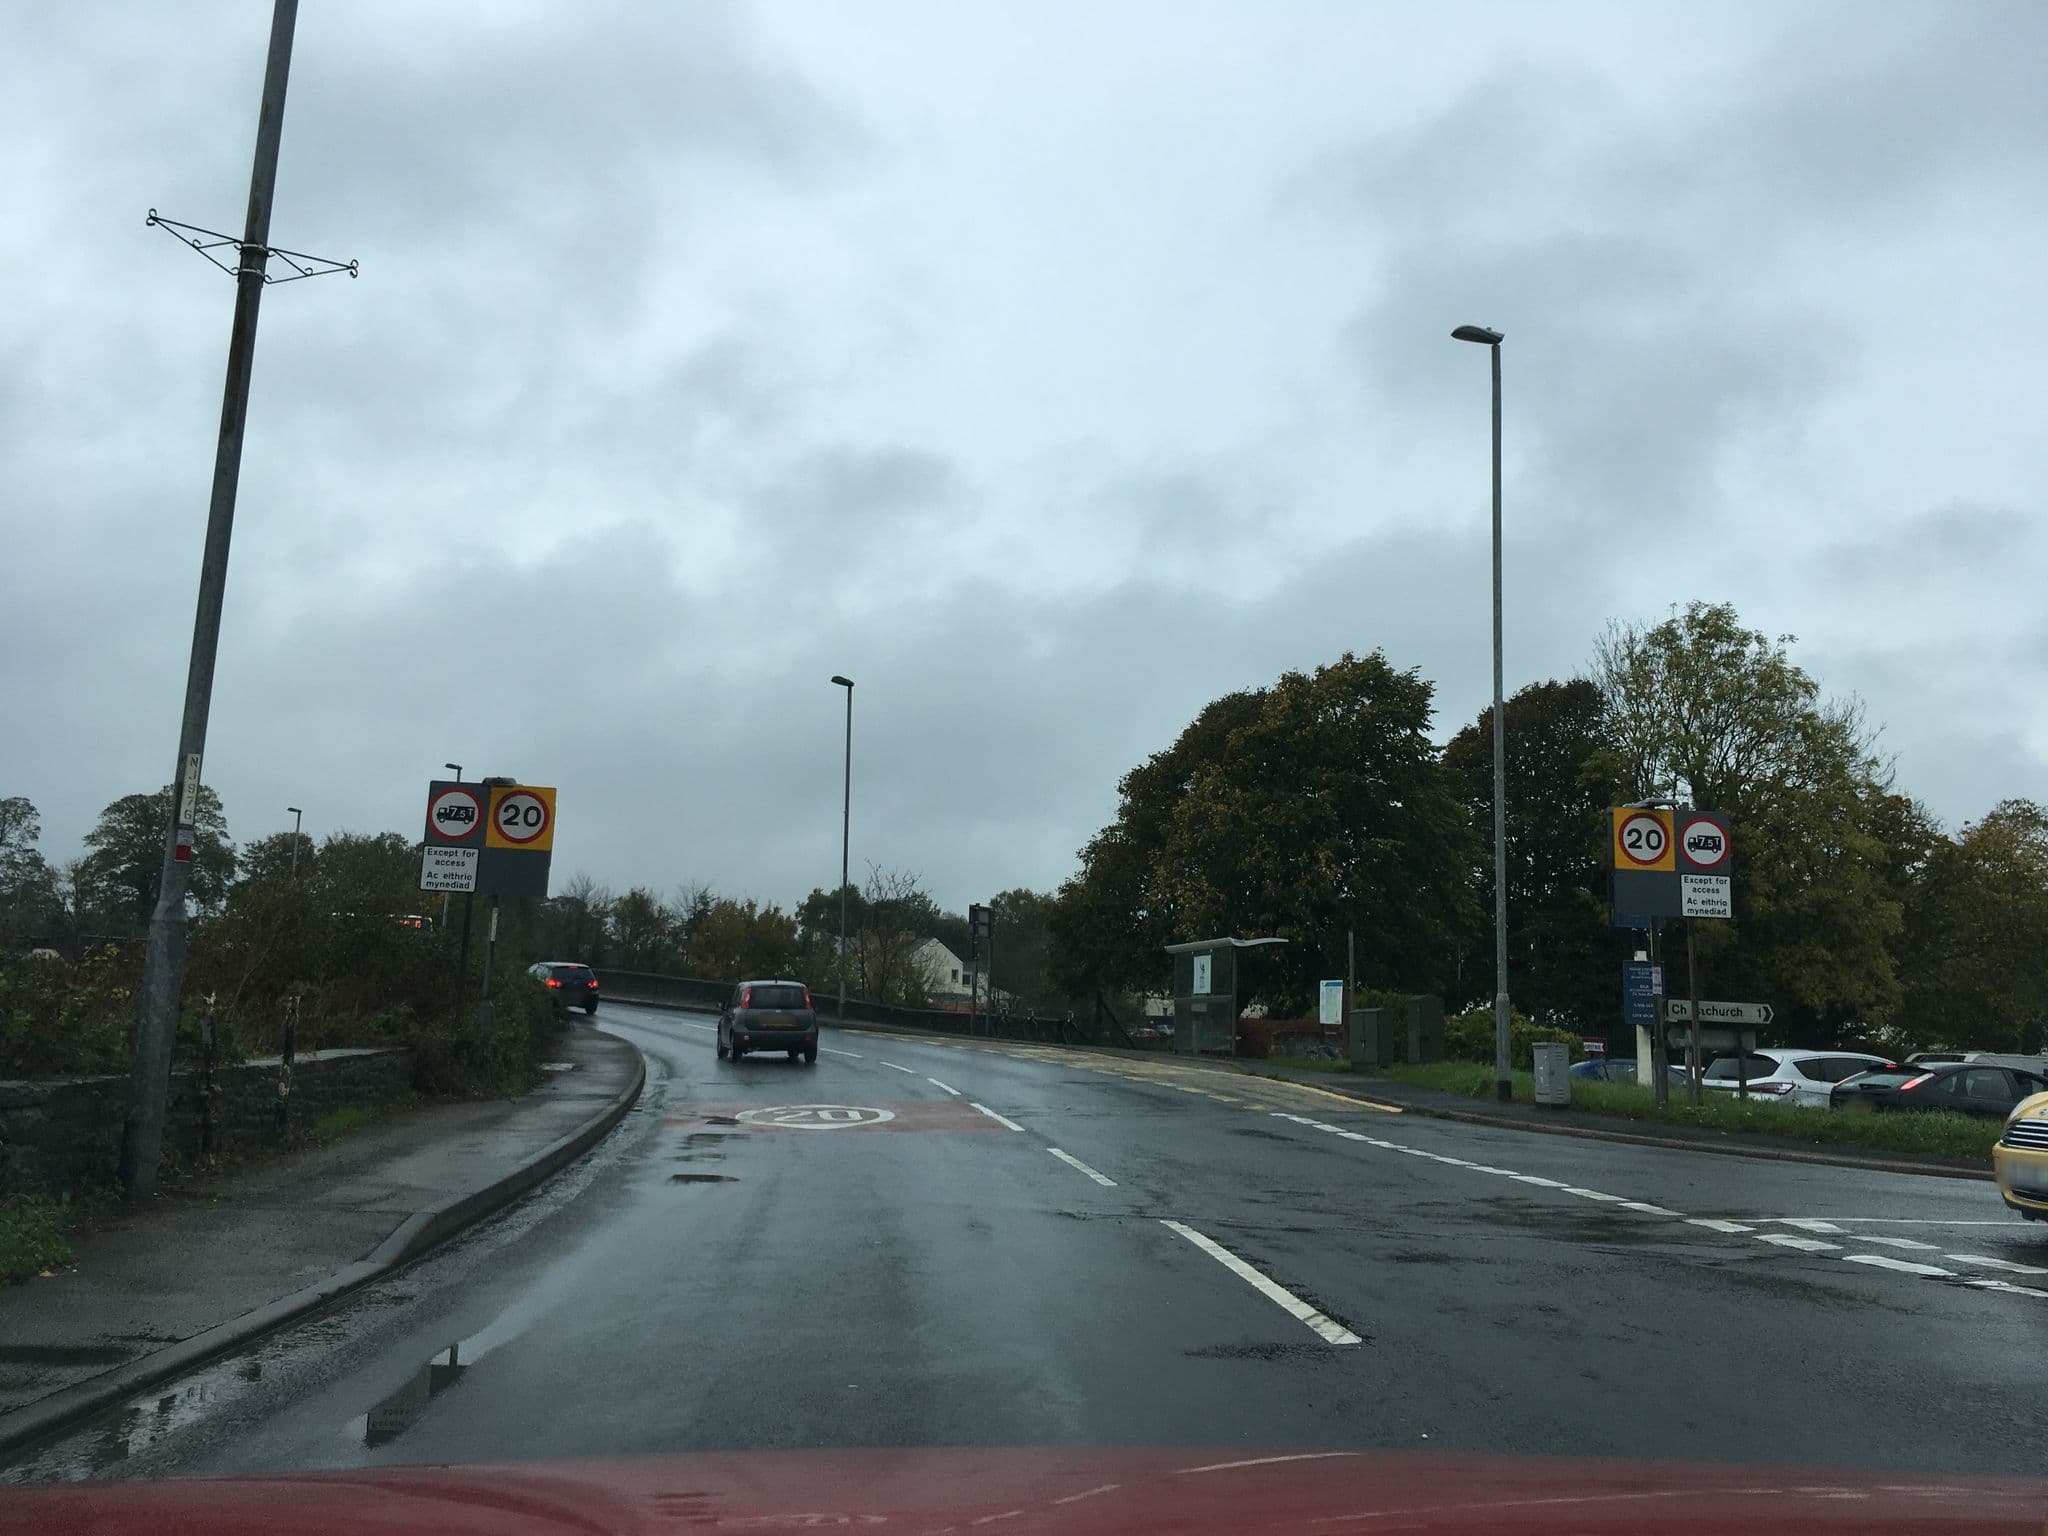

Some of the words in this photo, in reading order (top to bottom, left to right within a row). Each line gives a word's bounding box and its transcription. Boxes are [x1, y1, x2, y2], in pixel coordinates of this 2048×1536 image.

[503, 804, 542, 827] 20
[1627, 828, 1663, 850] 20
[427, 848, 458, 858] Except
[462, 850, 475, 858] for
[434, 859, 466, 867] access
[426, 870, 439, 880] Ac
[442, 871, 472, 881] eithrio
[1683, 875, 1712, 884] Except
[1715, 877, 1728, 885] for
[426, 880, 470, 890] mynediad
[1687, 897, 1697, 905] Ac
[1701, 898, 1728, 906] eithrio
[1687, 907, 1727, 916] mynediad
[773, 1110, 863, 1121] 20
